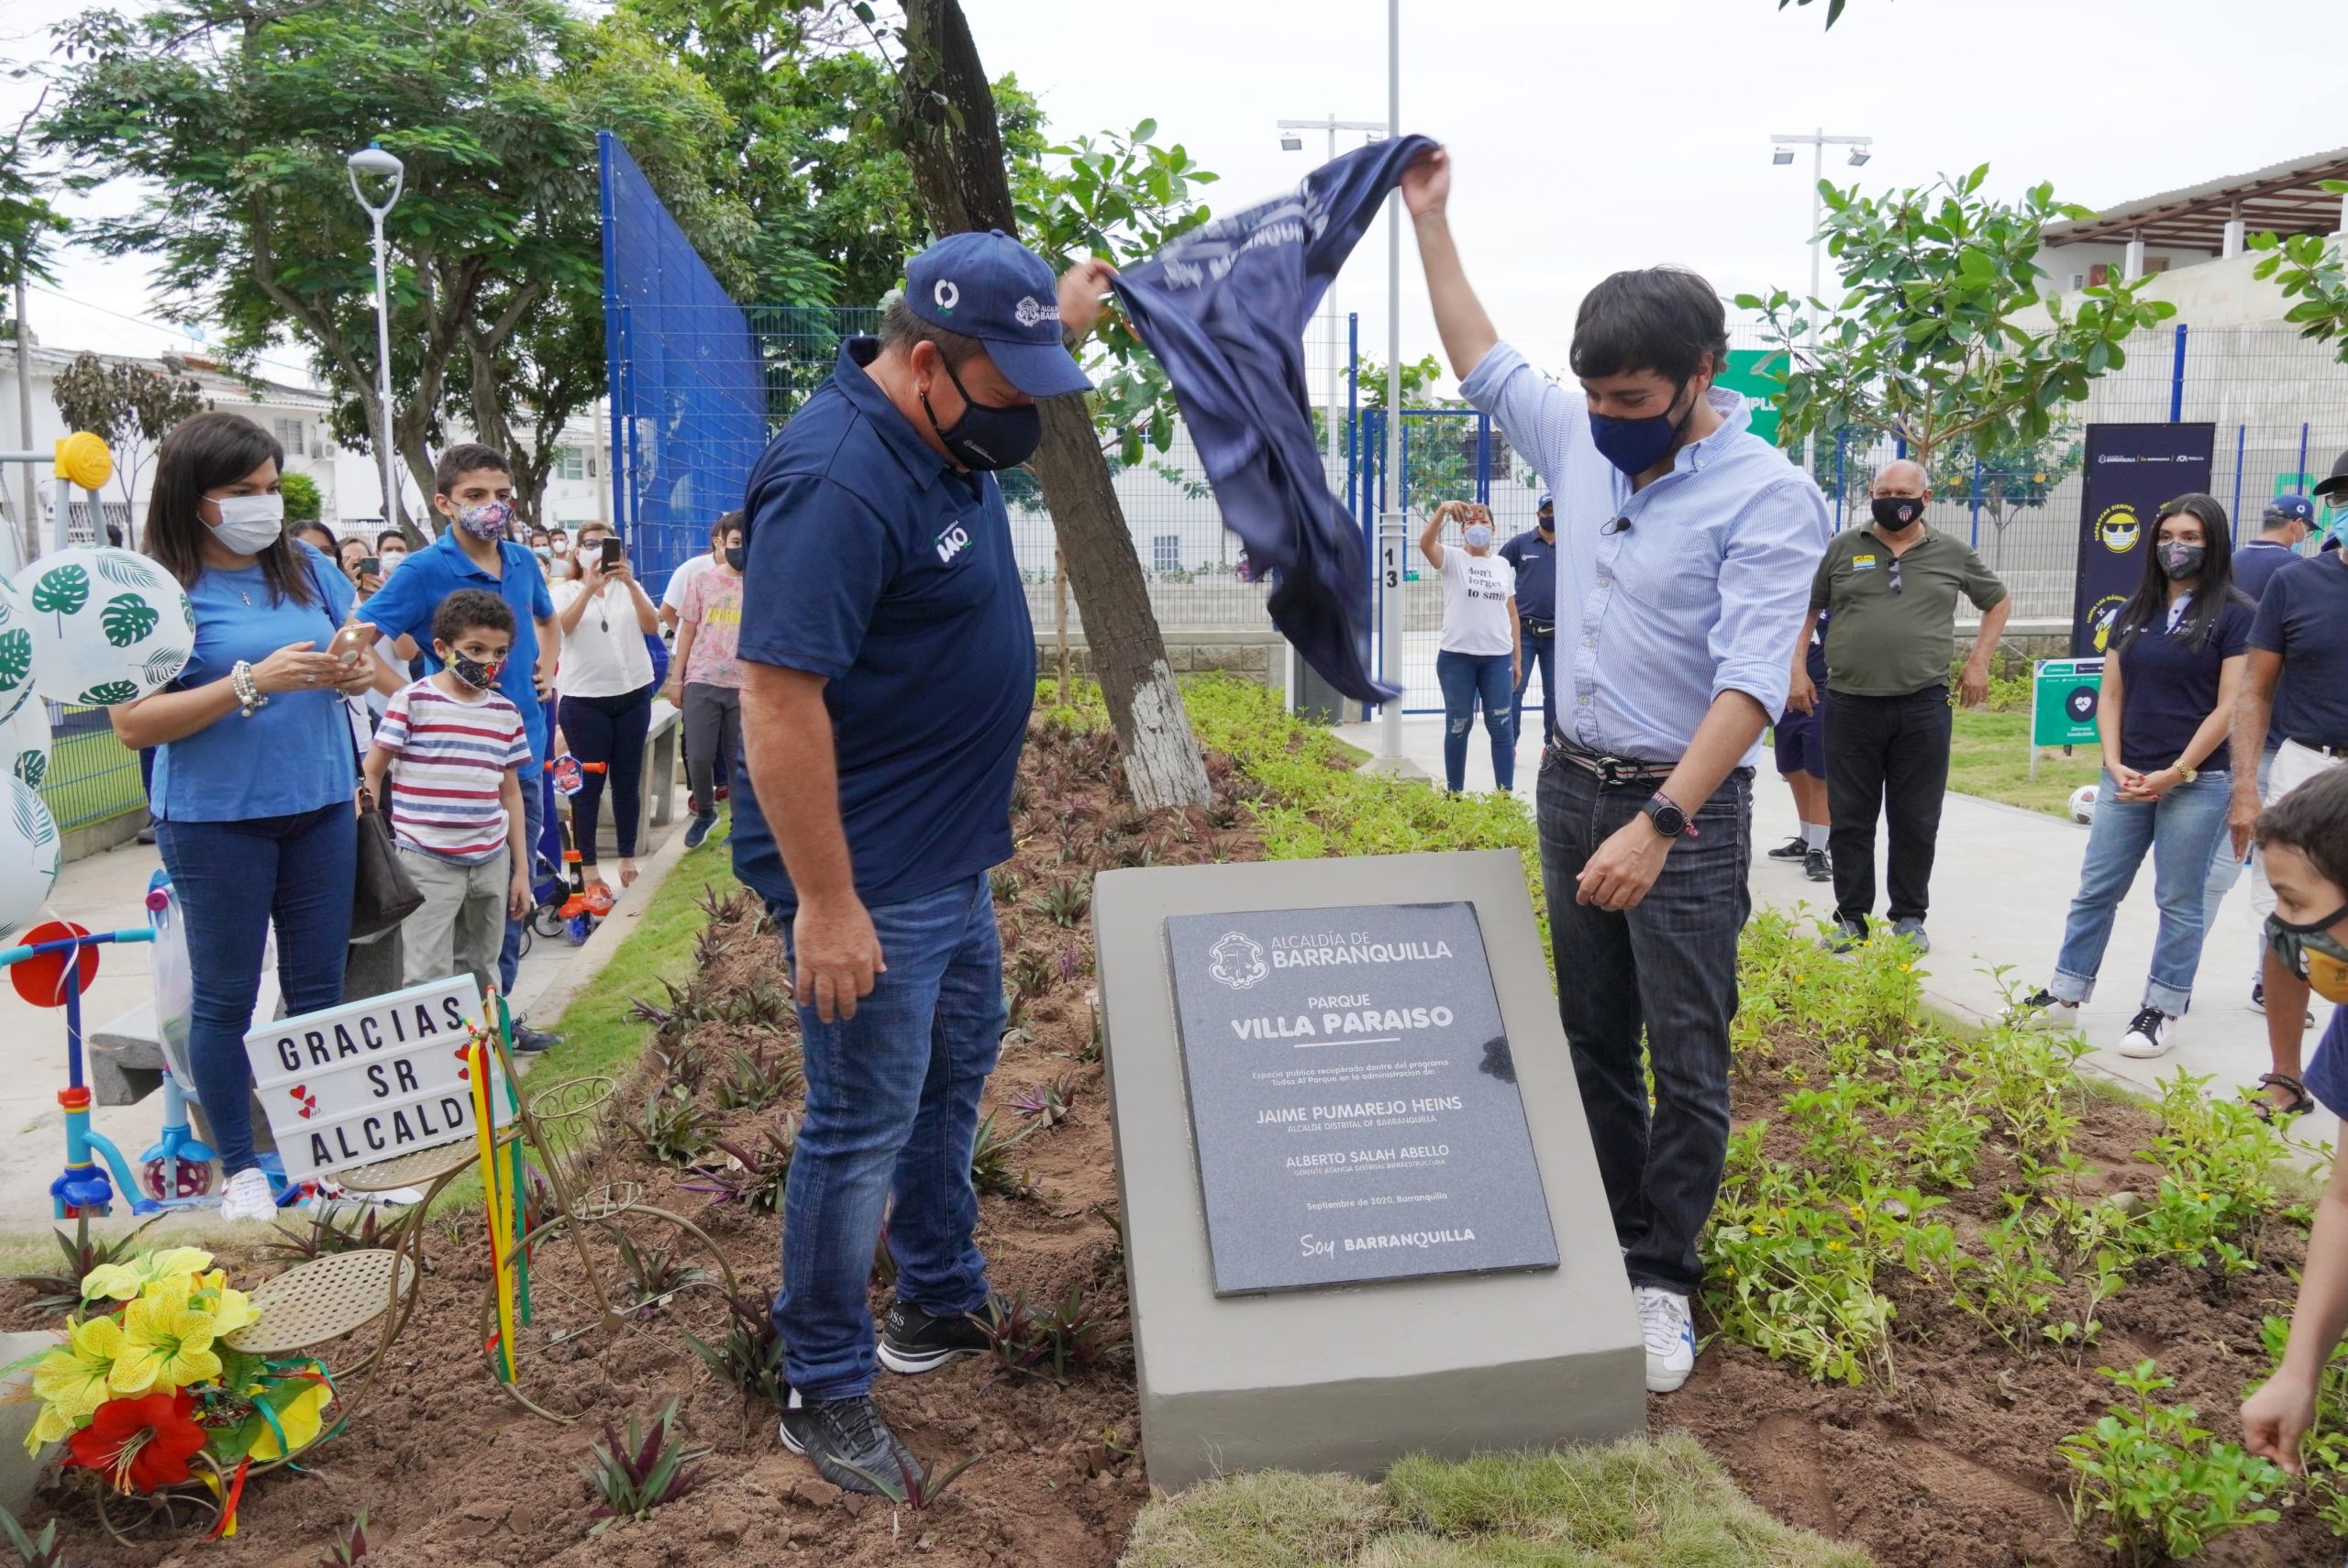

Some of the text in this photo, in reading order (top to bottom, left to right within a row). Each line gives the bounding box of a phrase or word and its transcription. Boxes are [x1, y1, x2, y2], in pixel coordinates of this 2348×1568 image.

[2110, 503, 2135, 513] SIEMPRE
[1468, 589, 1479, 598] to
[1271, 931, 1371, 949] ALCALDÍA DE
[1272, 941, 1453, 968] BARRANQUILLA
[1307, 993, 1372, 1010] PARQUE
[1231, 1006, 1454, 1041] VILLA PARAISO
[277, 996, 463, 1072] GRACIAS
[367, 1058, 419, 1099] SR
[1252, 1059, 1449, 1080] Espacio publico recuperado dentro del programa
[1271, 1078, 1296, 1087] Todos
[1297, 1077, 1306, 1085] Al
[1308, 1076, 1337, 1085] Parque
[1256, 1096, 1463, 1124] JAIME PUMAREJO HEINS
[1287, 1123, 1323, 1133] ALCALDE
[1324, 1121, 1362, 1131] DISTRITAL
[1376, 1115, 1437, 1127] BARRANQUILLA
[1286, 1144, 1449, 1168] ALBERTO SALAH ABELLO
[1293, 1159, 1446, 1176] GERENTE AGENCIA DISTRITAL INFRAESTRUCTURA
[1306, 1192, 1447, 1211] Septiembre de 2020, Barranquilla
[1300, 1228, 1476, 1260] Soy BARRANQUILLA
[889, 1308, 905, 1327] OSS
